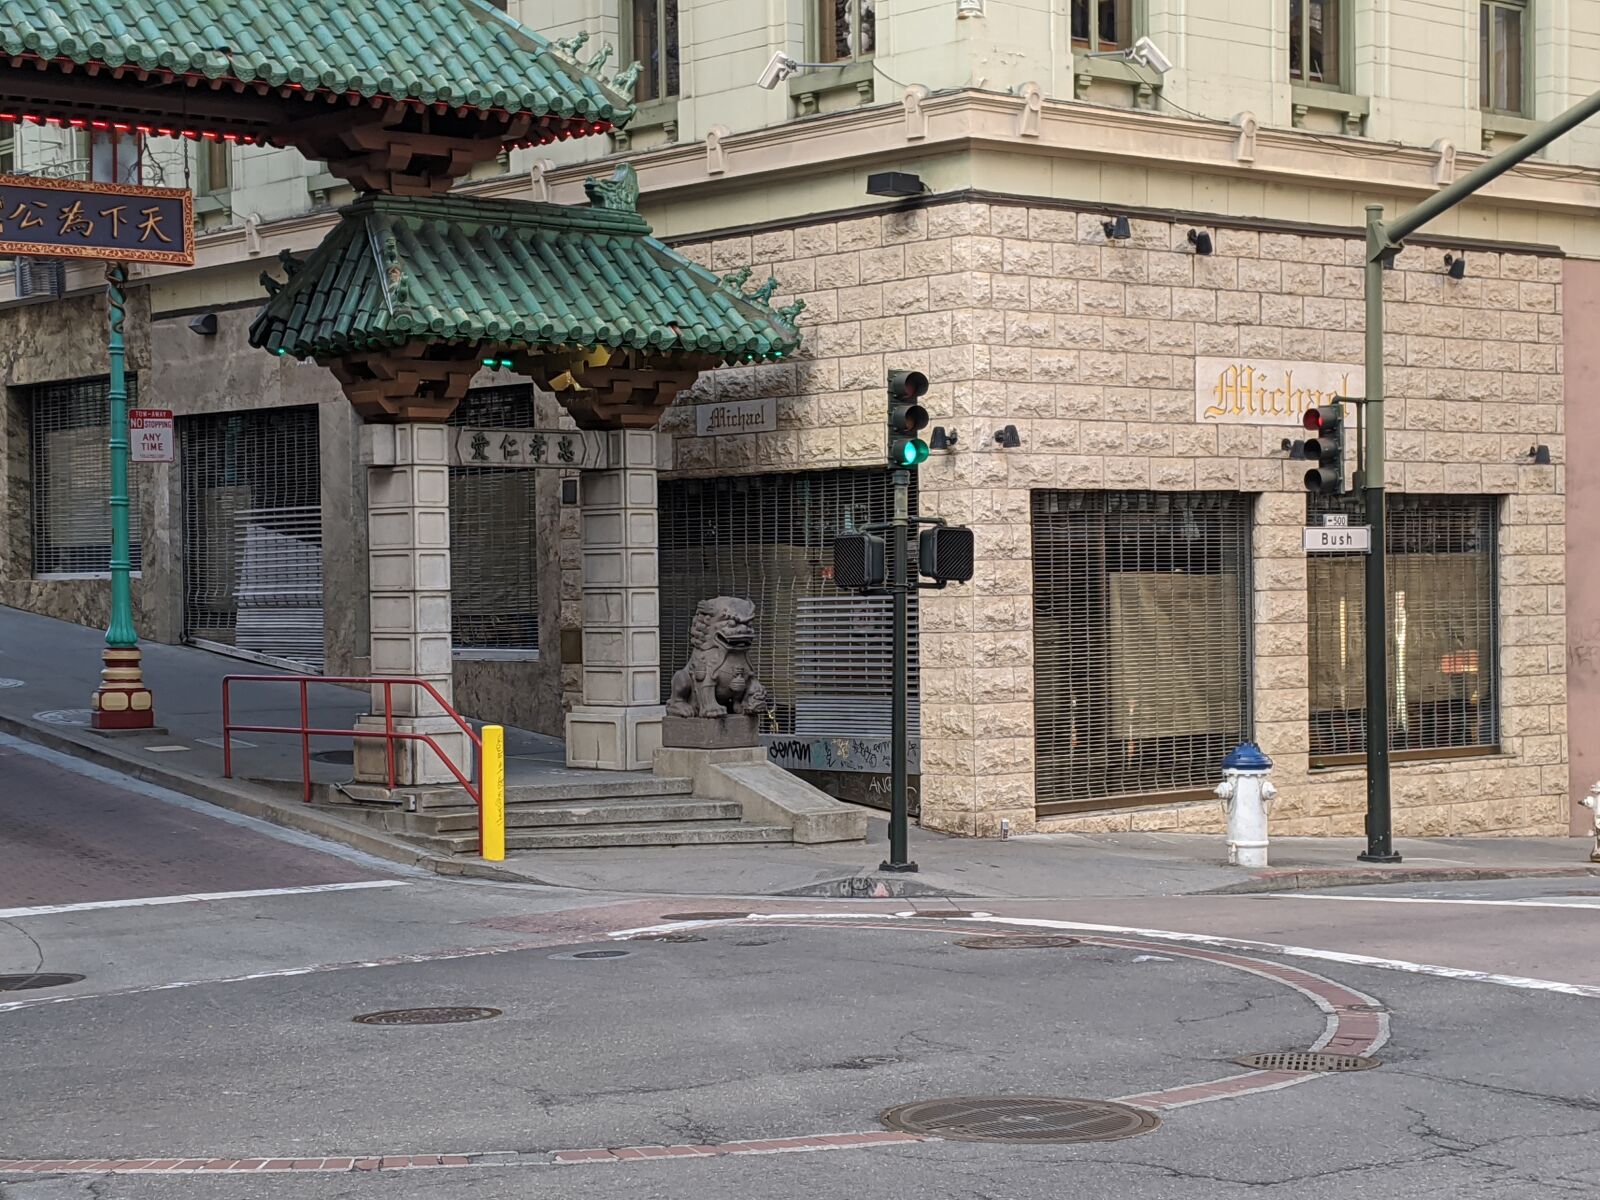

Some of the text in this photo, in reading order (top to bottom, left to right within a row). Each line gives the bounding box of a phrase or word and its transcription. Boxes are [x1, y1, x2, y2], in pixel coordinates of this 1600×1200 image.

[136, 410, 167, 418] TOW-AWAY
[706, 404, 765, 432] Michael
[130, 417, 172, 429] NO STOPPING
[143, 433, 161, 441] ANY
[141, 443, 164, 451] TIME
[1321, 532, 1353, 546] Bush
